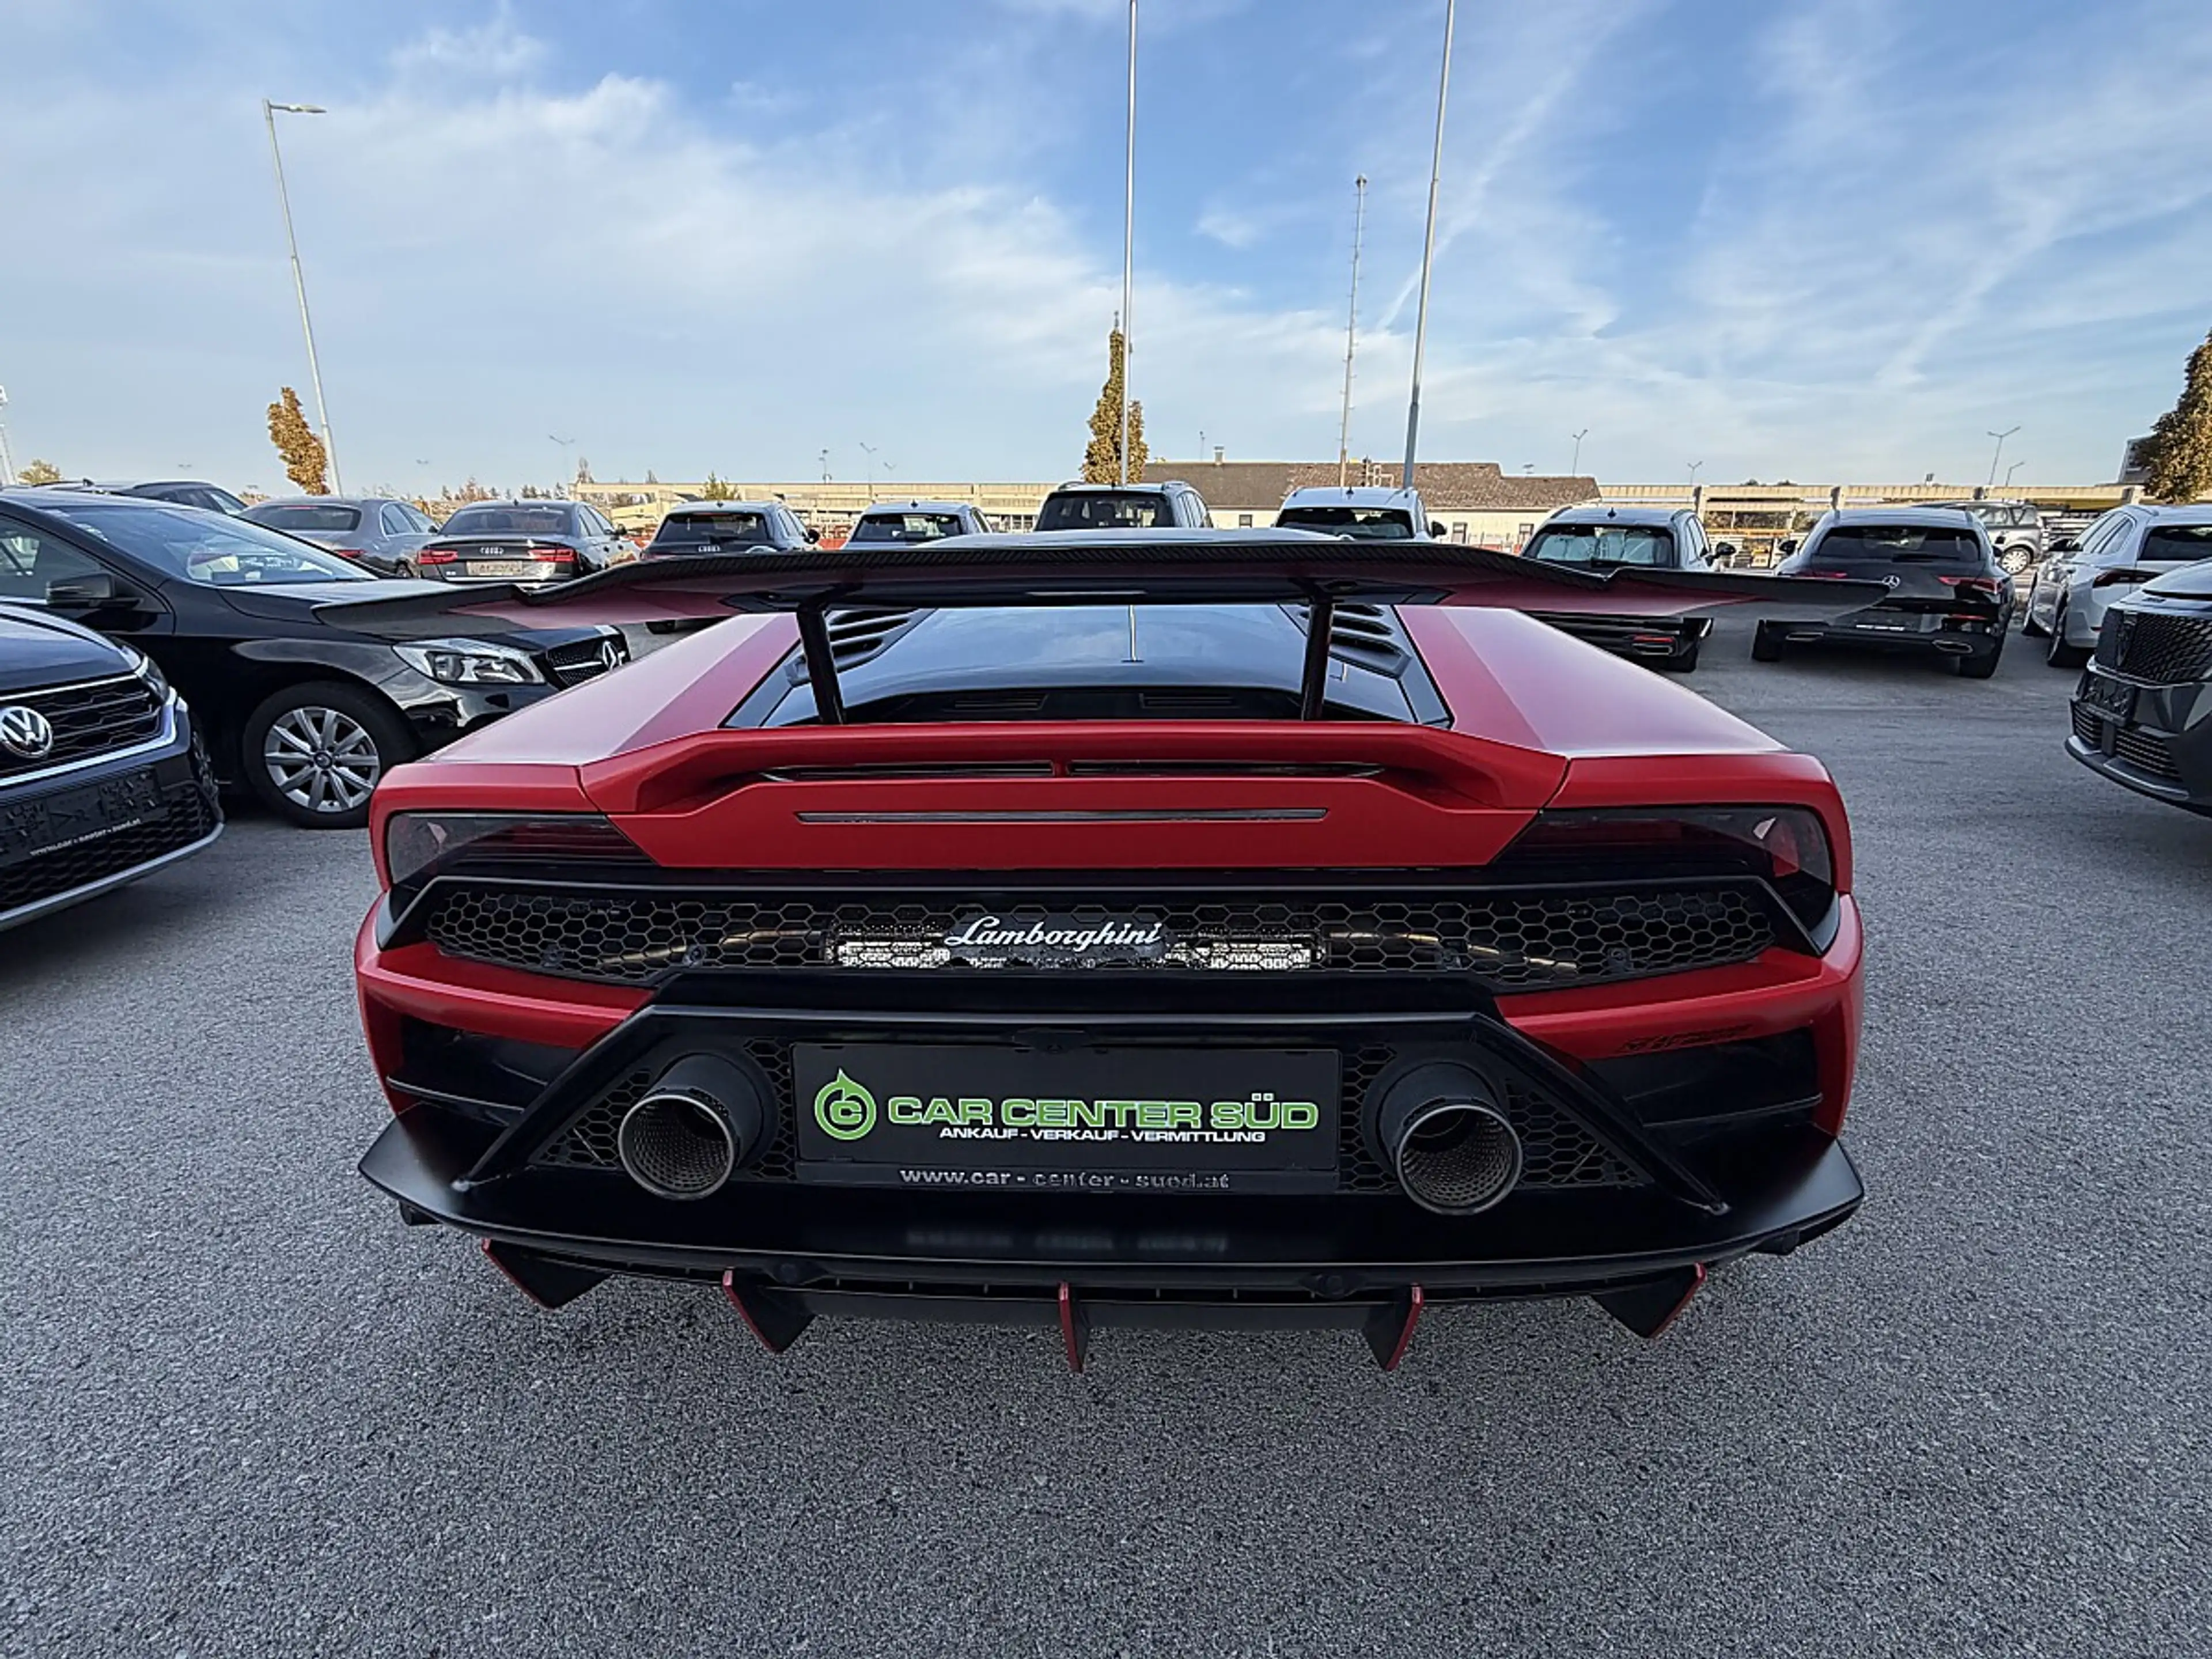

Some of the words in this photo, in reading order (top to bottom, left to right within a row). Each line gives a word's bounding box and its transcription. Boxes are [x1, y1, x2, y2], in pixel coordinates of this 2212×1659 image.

[944, 916, 1162, 952] Lamborghini
[888, 1097, 993, 1125] CAR
[1001, 1099, 1202, 1128] CENTER
[1210, 1093, 1319, 1129] SÜD
